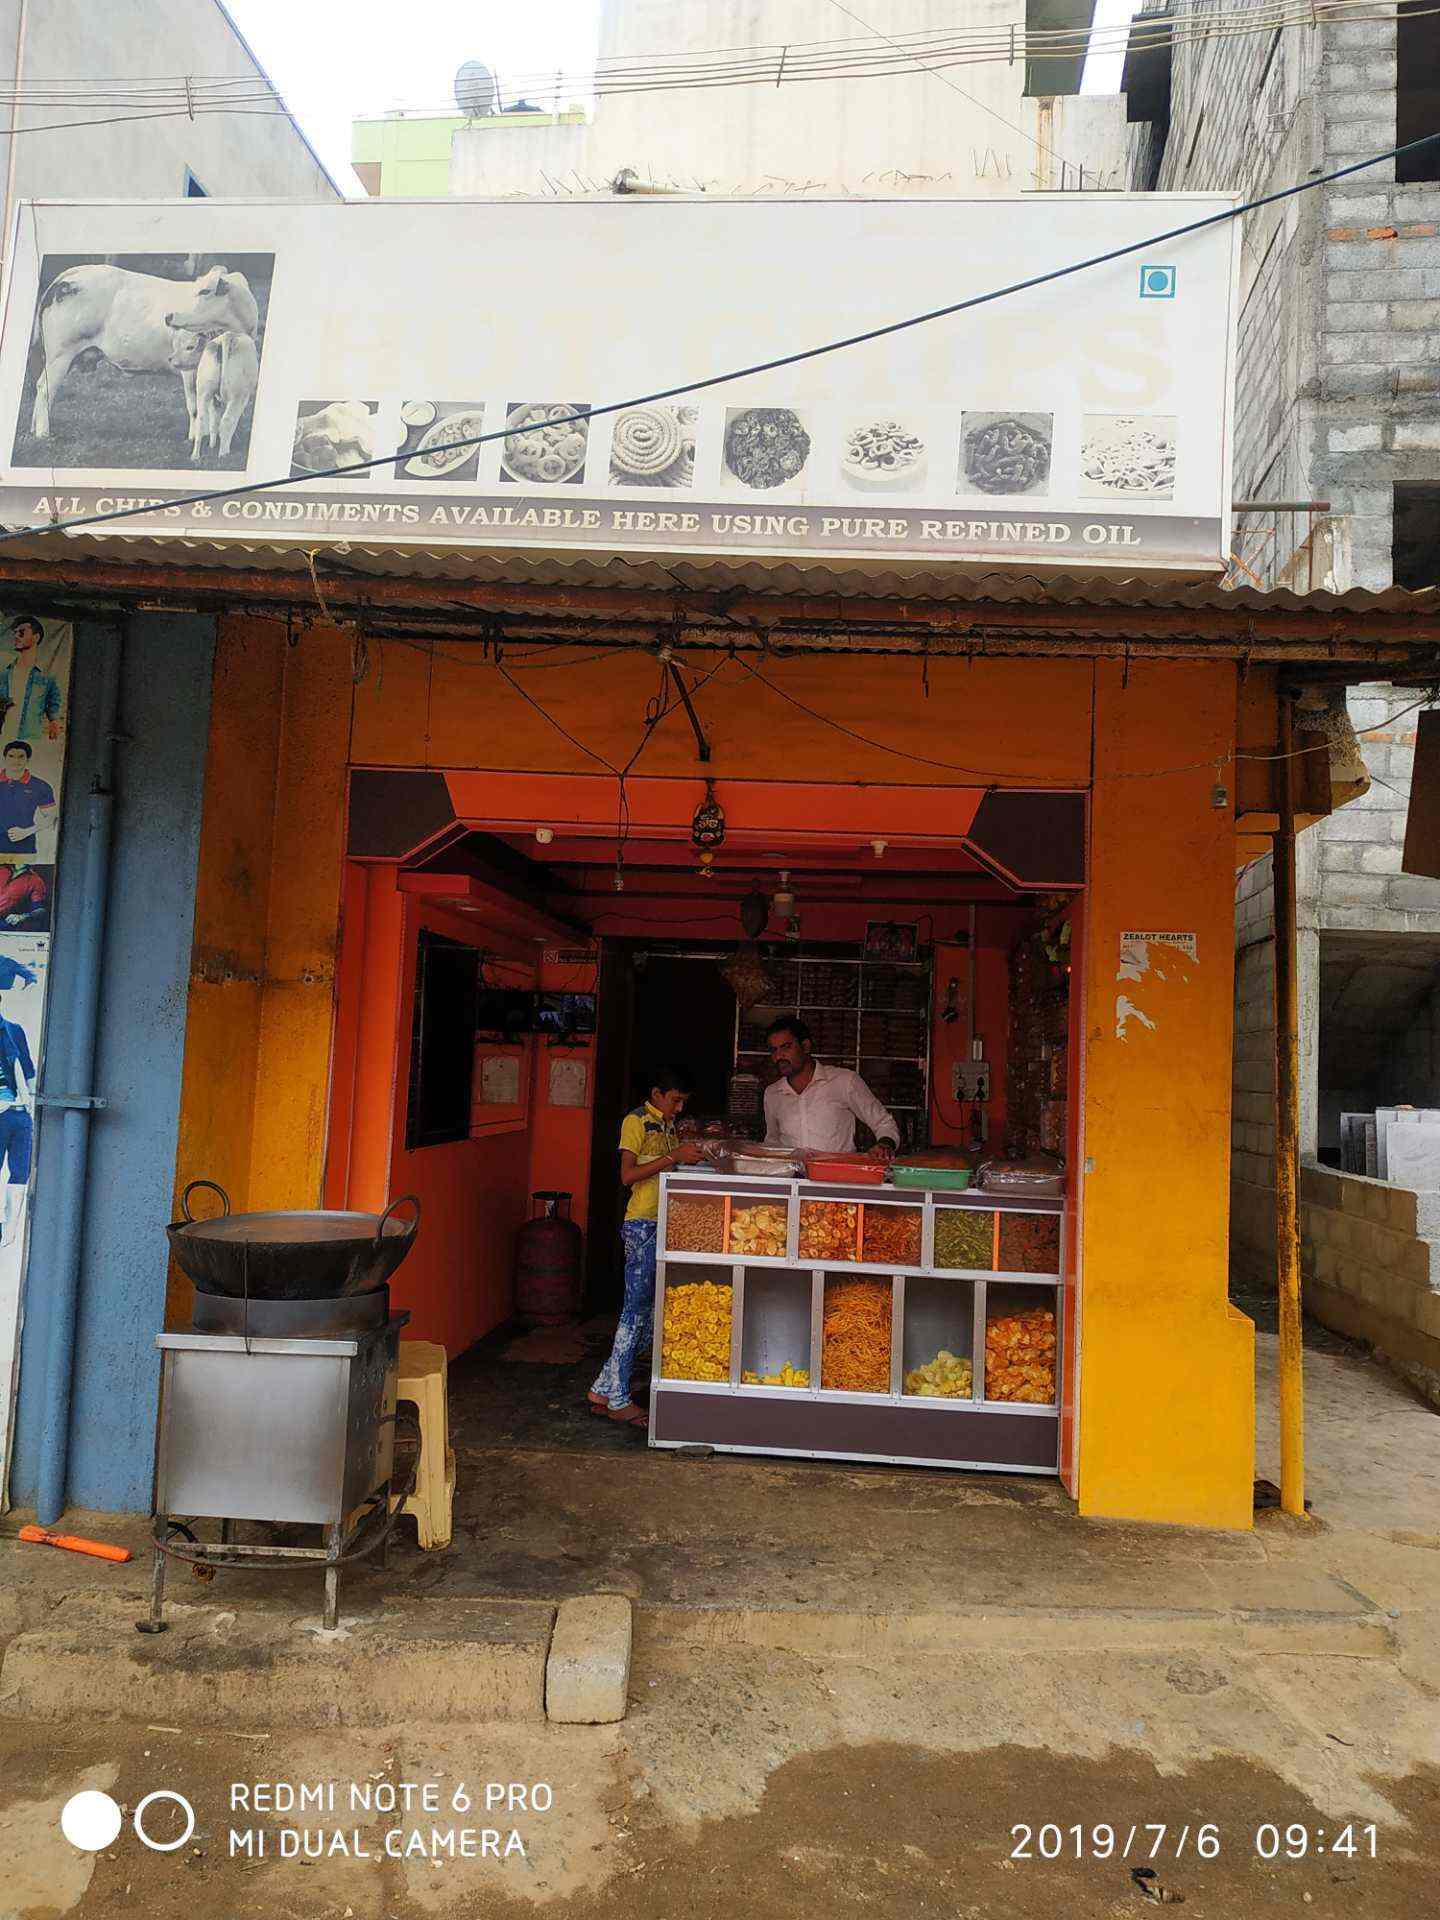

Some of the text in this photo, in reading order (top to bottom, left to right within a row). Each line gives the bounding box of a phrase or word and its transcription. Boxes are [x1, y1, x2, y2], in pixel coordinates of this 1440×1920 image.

[32, 496, 1142, 545] ALL CHIPS & CONDIMENTS AVAILABLE HERE USING PURE REFINED OIL
[1123, 933, 1194, 942] ZEALOT HEARTS
